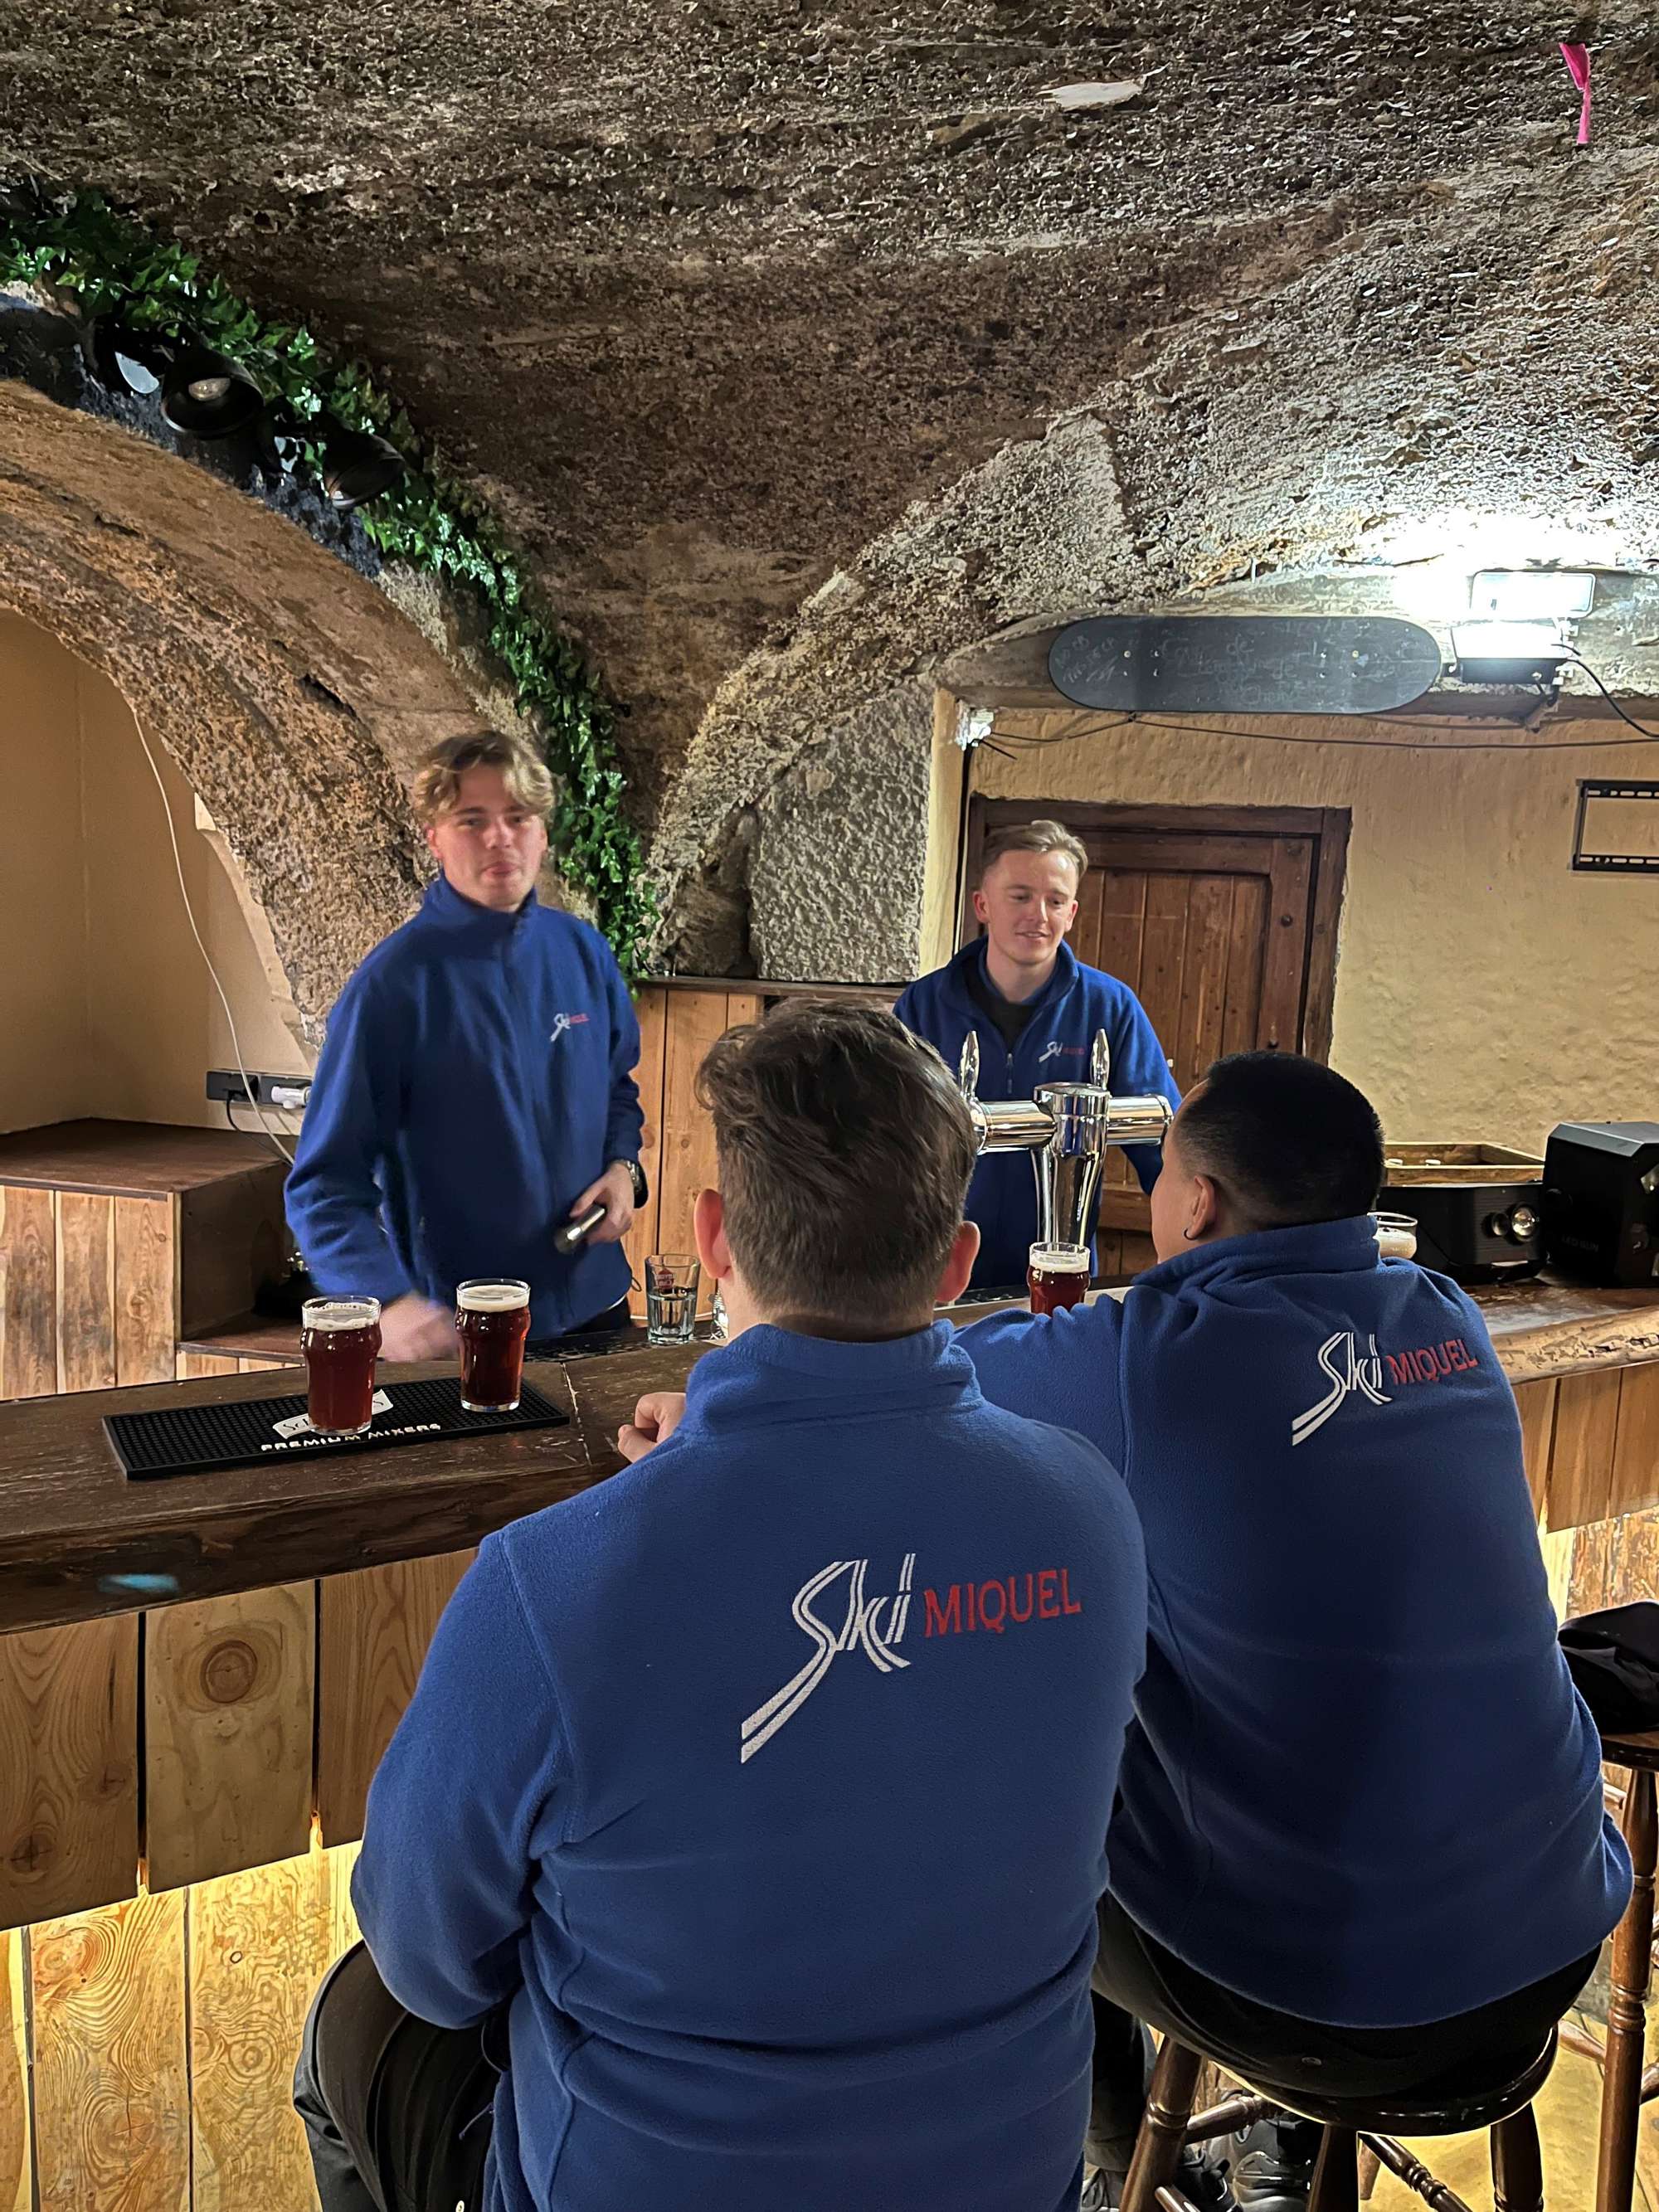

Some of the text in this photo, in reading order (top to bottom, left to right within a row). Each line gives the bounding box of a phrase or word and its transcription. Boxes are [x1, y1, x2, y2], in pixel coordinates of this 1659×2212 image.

[261, 1423, 441, 1451] PREMIUM MIXERS
[1292, 1332, 1478, 1446] Ski MIQUEL
[741, 1553, 1082, 1764] Ski MIQUEL
